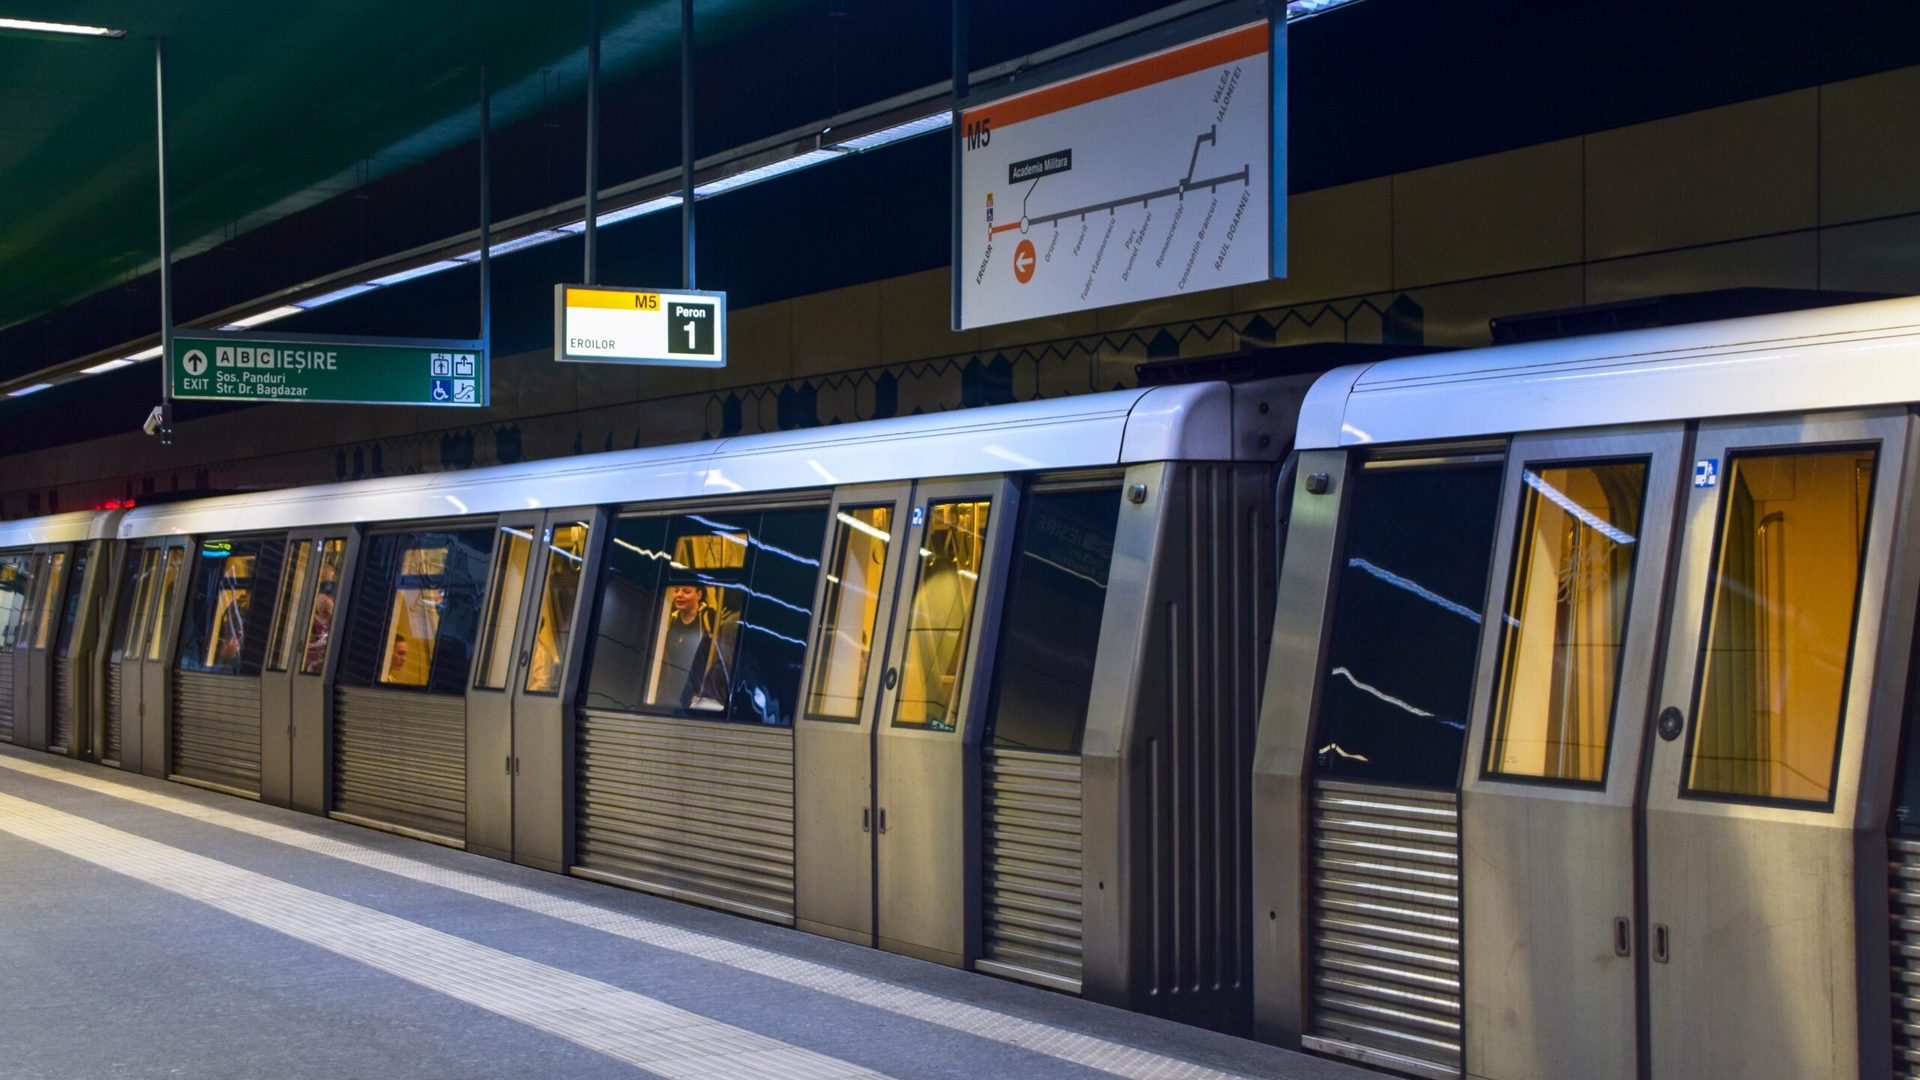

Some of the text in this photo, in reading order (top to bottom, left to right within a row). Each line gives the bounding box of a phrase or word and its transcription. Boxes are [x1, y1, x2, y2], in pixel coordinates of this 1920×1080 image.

[1213, 69, 1230, 104] VALEA
[967, 117, 991, 152] M5
[1013, 162, 1043, 179] Academia
[1073, 224, 1088, 256] Favorit
[1124, 228, 1137, 250] Parc
[1155, 202, 1184, 269] Romancierilor
[1178, 197, 1218, 290] Constantin Brancusi
[1214, 190, 1250, 272] RAUL DOAMNEI
[1045, 230, 1059, 263] Orizont
[1080, 217, 1116, 301] Tudor Vladimirescu
[1121, 211, 1152, 282] Drumul Taberei
[975, 244, 993, 285] EROILOR
[635, 295, 657, 309] M5
[676, 306, 706, 318] Peron
[570, 338, 616, 350] EROILOR
[683, 320, 696, 349] 1
[216, 370, 286, 384] Sos. Panduri
[220, 350, 338, 374] A B C IEȘIRE
[183, 378, 209, 390] EXIT
[216, 382, 309, 398] Str. Dr. Bagdazar
